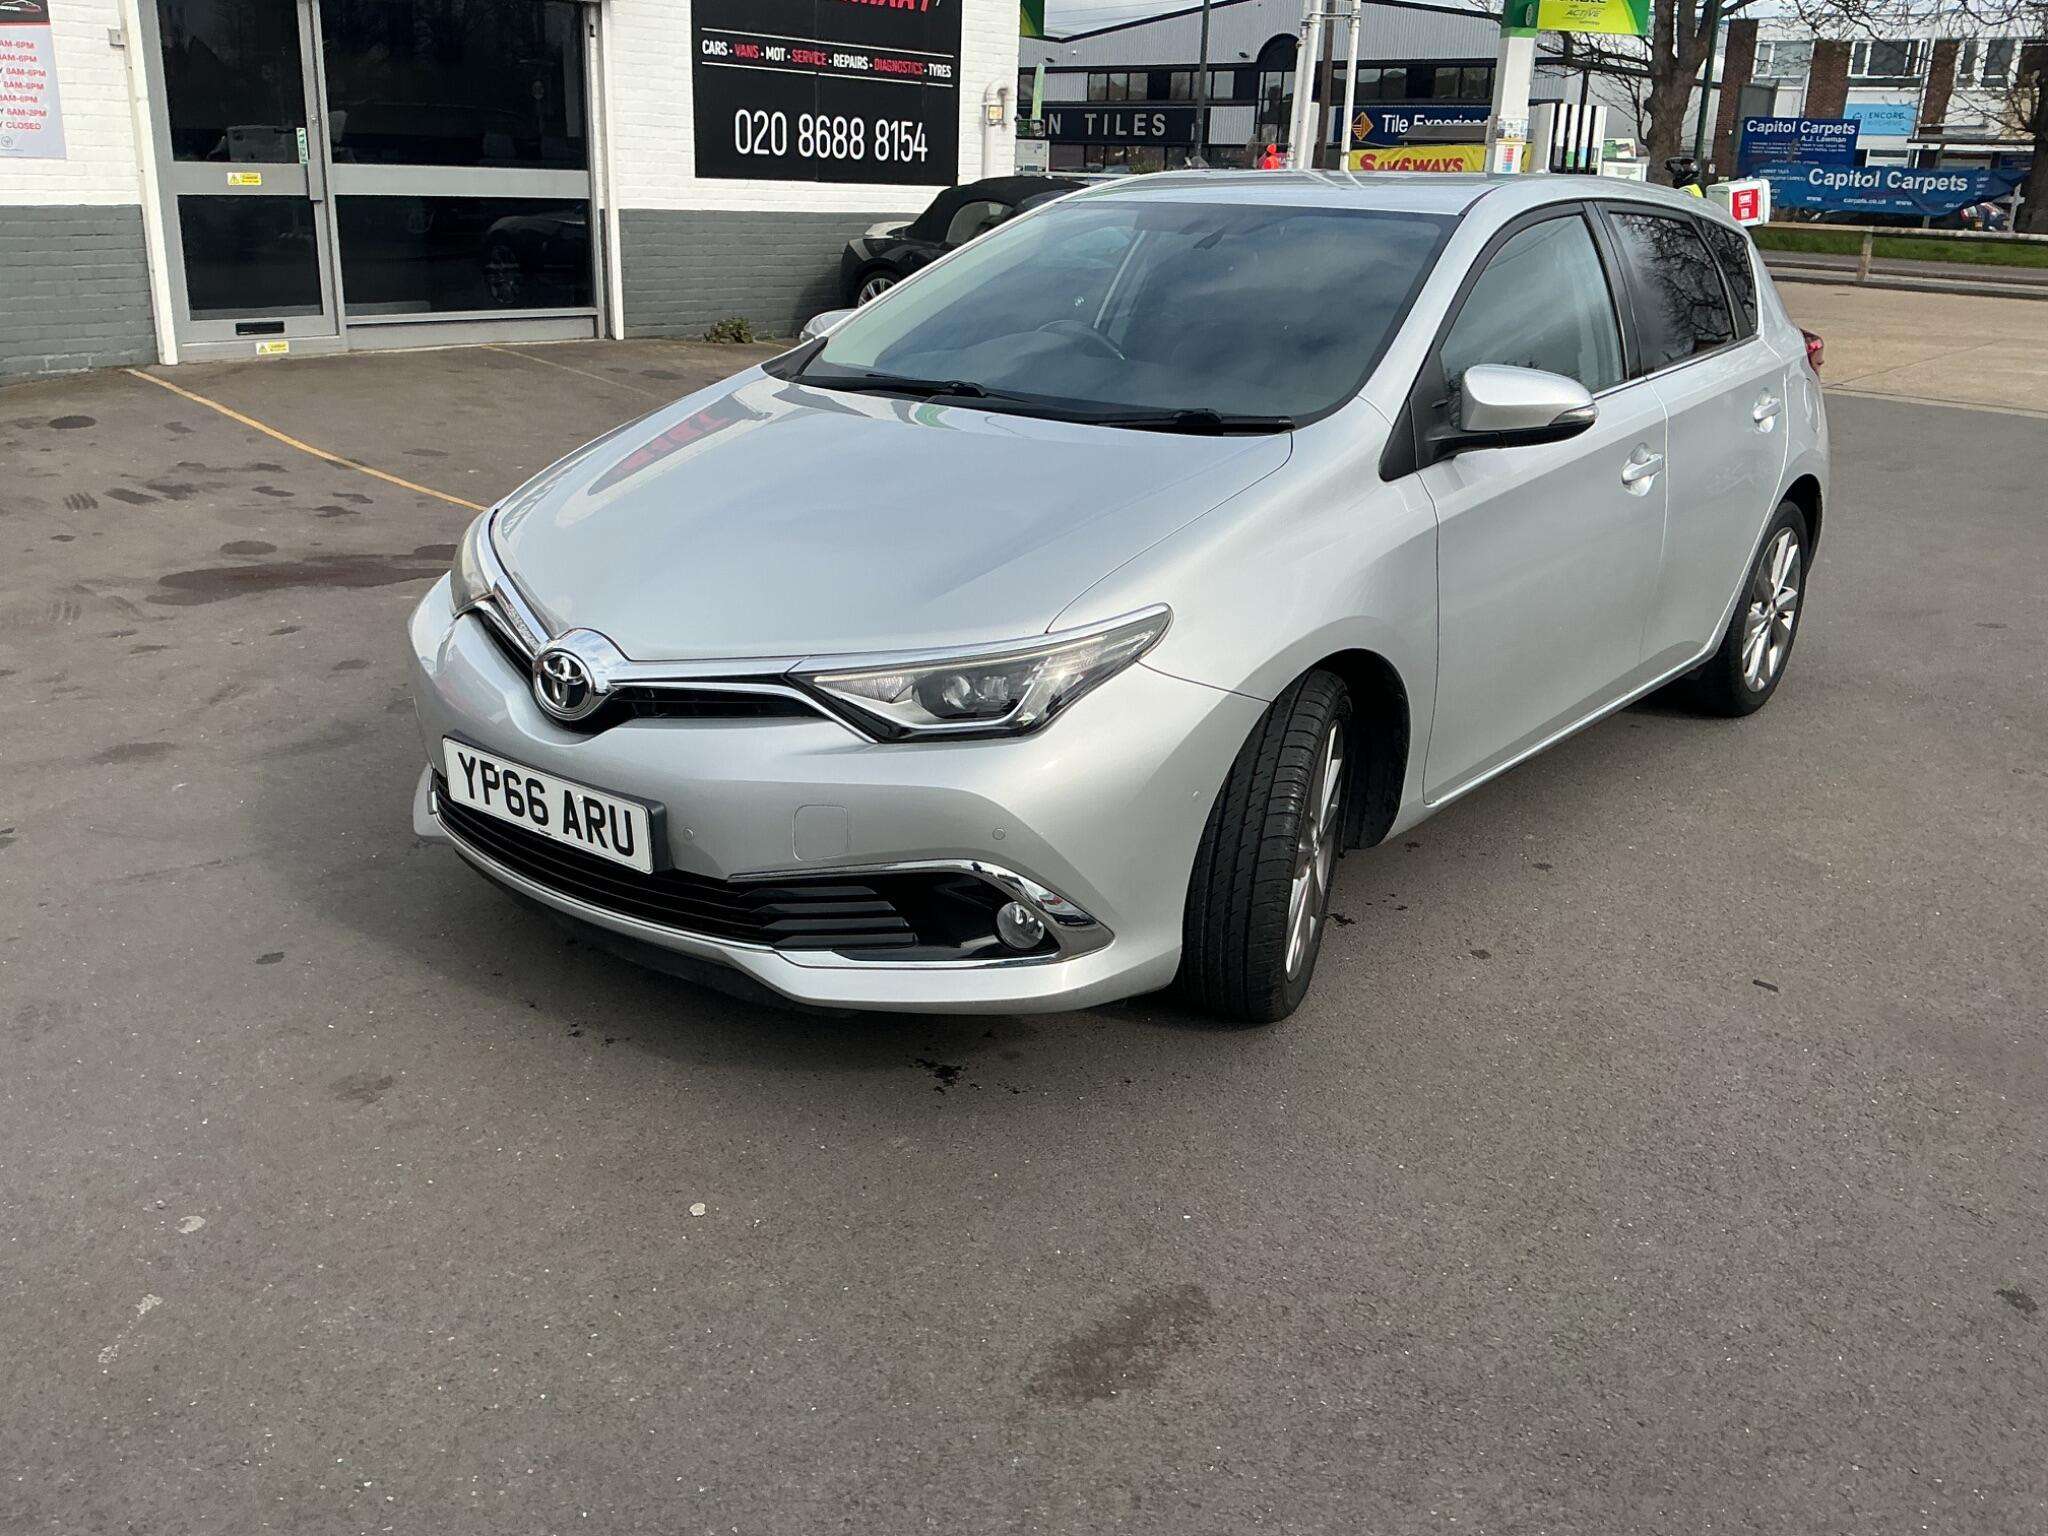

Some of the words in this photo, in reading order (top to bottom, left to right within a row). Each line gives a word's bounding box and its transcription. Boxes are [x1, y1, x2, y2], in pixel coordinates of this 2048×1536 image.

[702, 40, 727, 55] CARS
[734, 43, 759, 59] VANS
[766, 47, 785, 62] MOT
[792, 50, 827, 66] SERVICE
[833, 54, 868, 70] REPAIRS
[874, 58, 923, 75] DIAGNOSTICS
[928, 63, 952, 78] TYRES
[6, 121, 41, 130] CLOSED
[734, 109, 787, 156] 020
[798, 113, 865, 160] 8688
[875, 119, 928, 162] 8154
[1084, 113, 1166, 136] TILES
[1382, 114, 1409, 133] Tile
[1746, 120, 1796, 135] Capitol
[1800, 121, 1856, 136] Carpets
[1808, 168, 1880, 192] Capitol
[1887, 171, 1968, 193] Carpets
[458, 752, 549, 827] YP66
[562, 789, 634, 857] ARU
